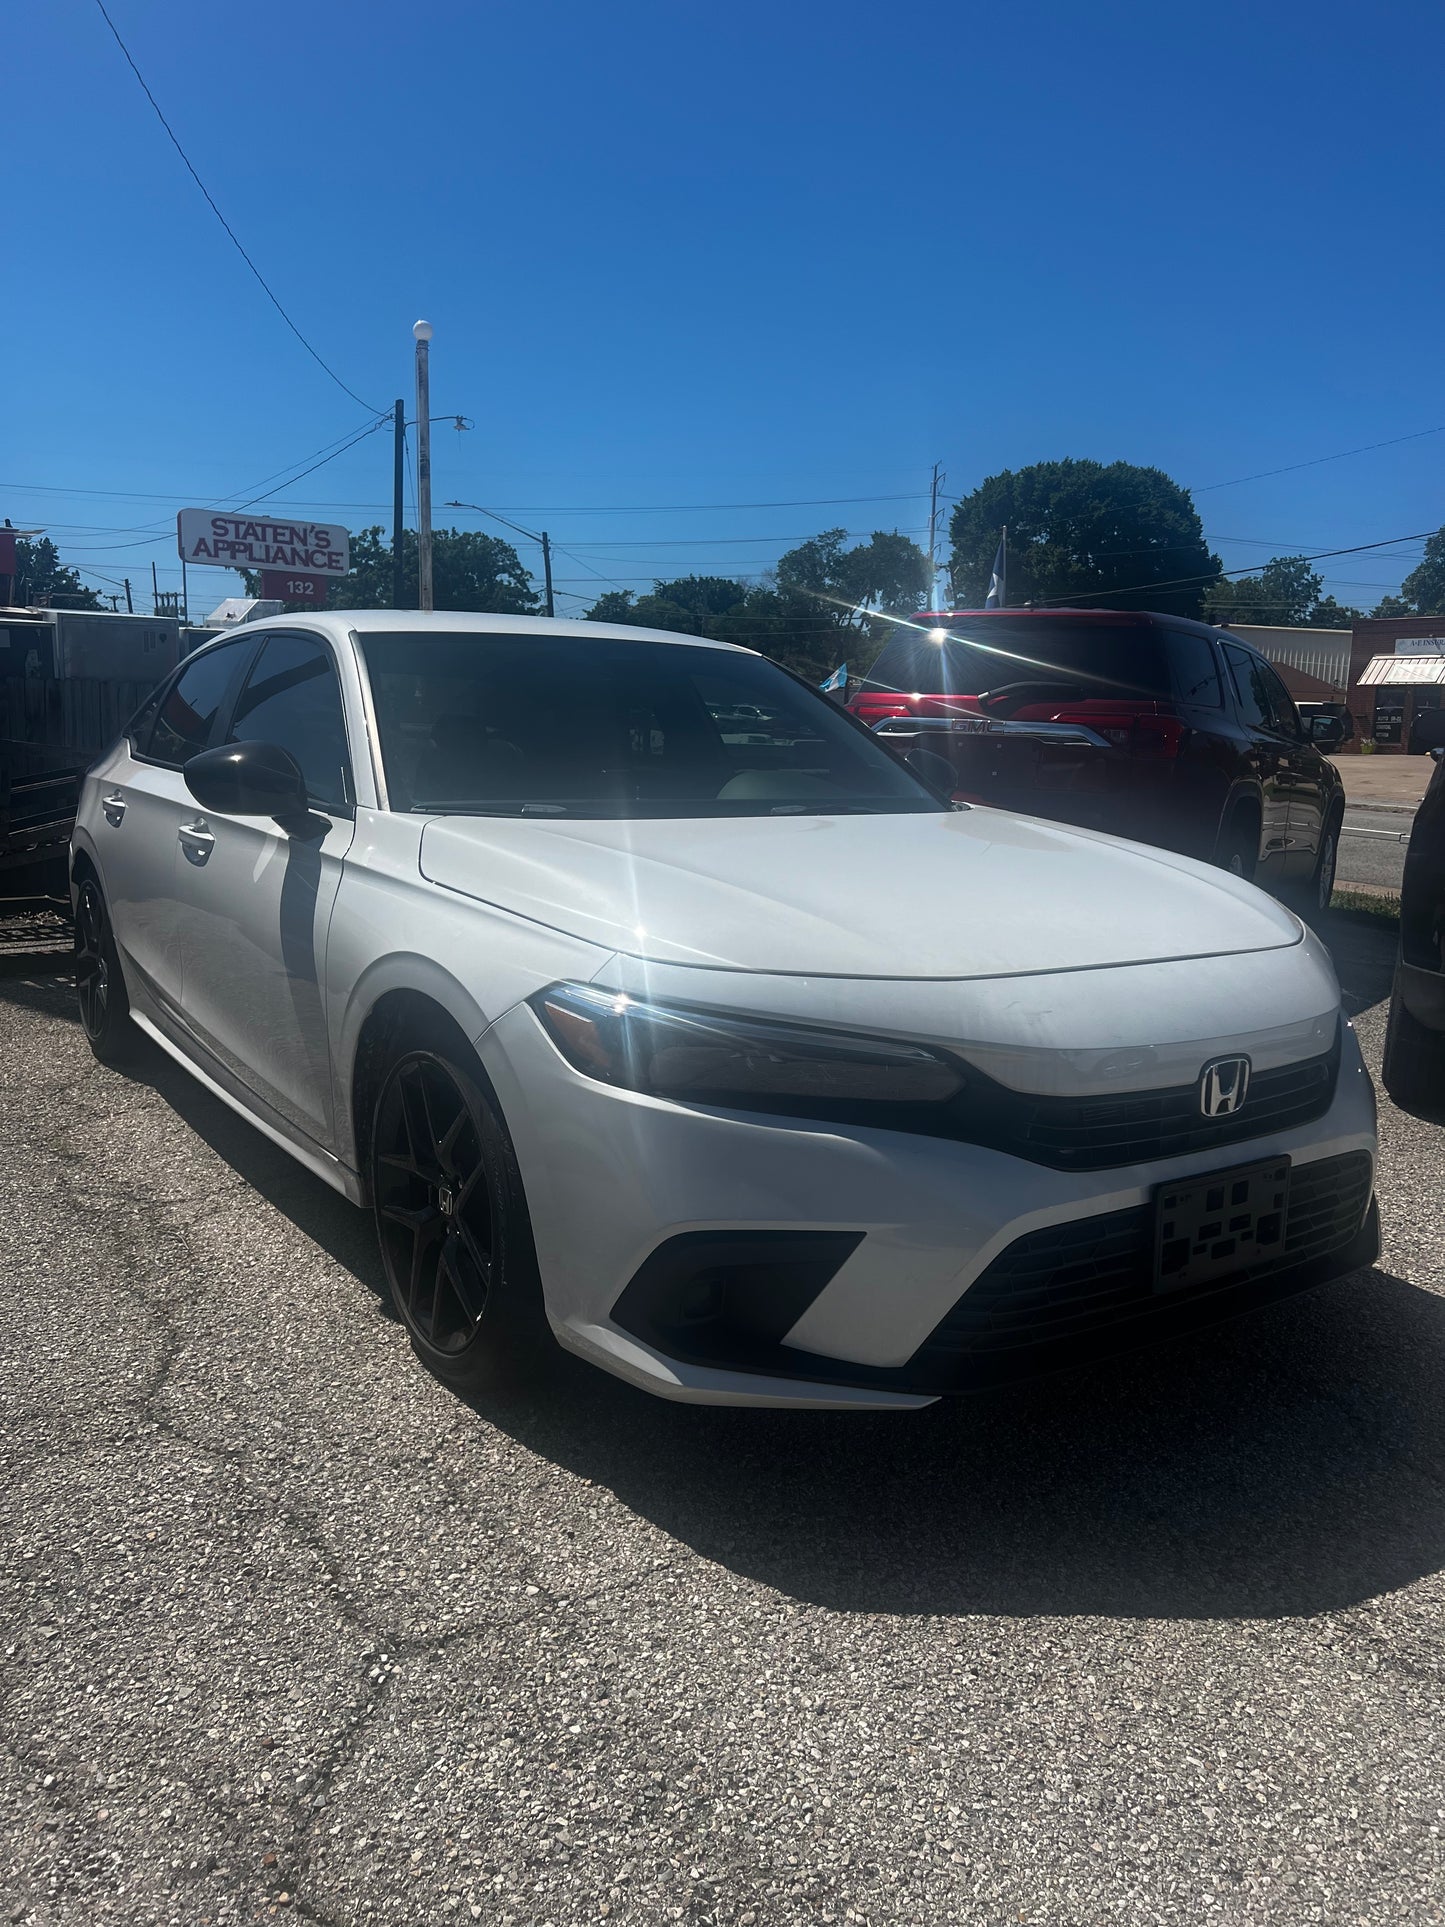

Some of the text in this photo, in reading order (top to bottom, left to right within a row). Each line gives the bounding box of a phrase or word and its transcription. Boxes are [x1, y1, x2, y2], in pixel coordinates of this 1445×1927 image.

[211, 517, 332, 549] STATEN'S
[192, 537, 344, 571] APPLIANCE
[286, 581, 314, 595] 132
[951, 719, 1006, 736] GMC
